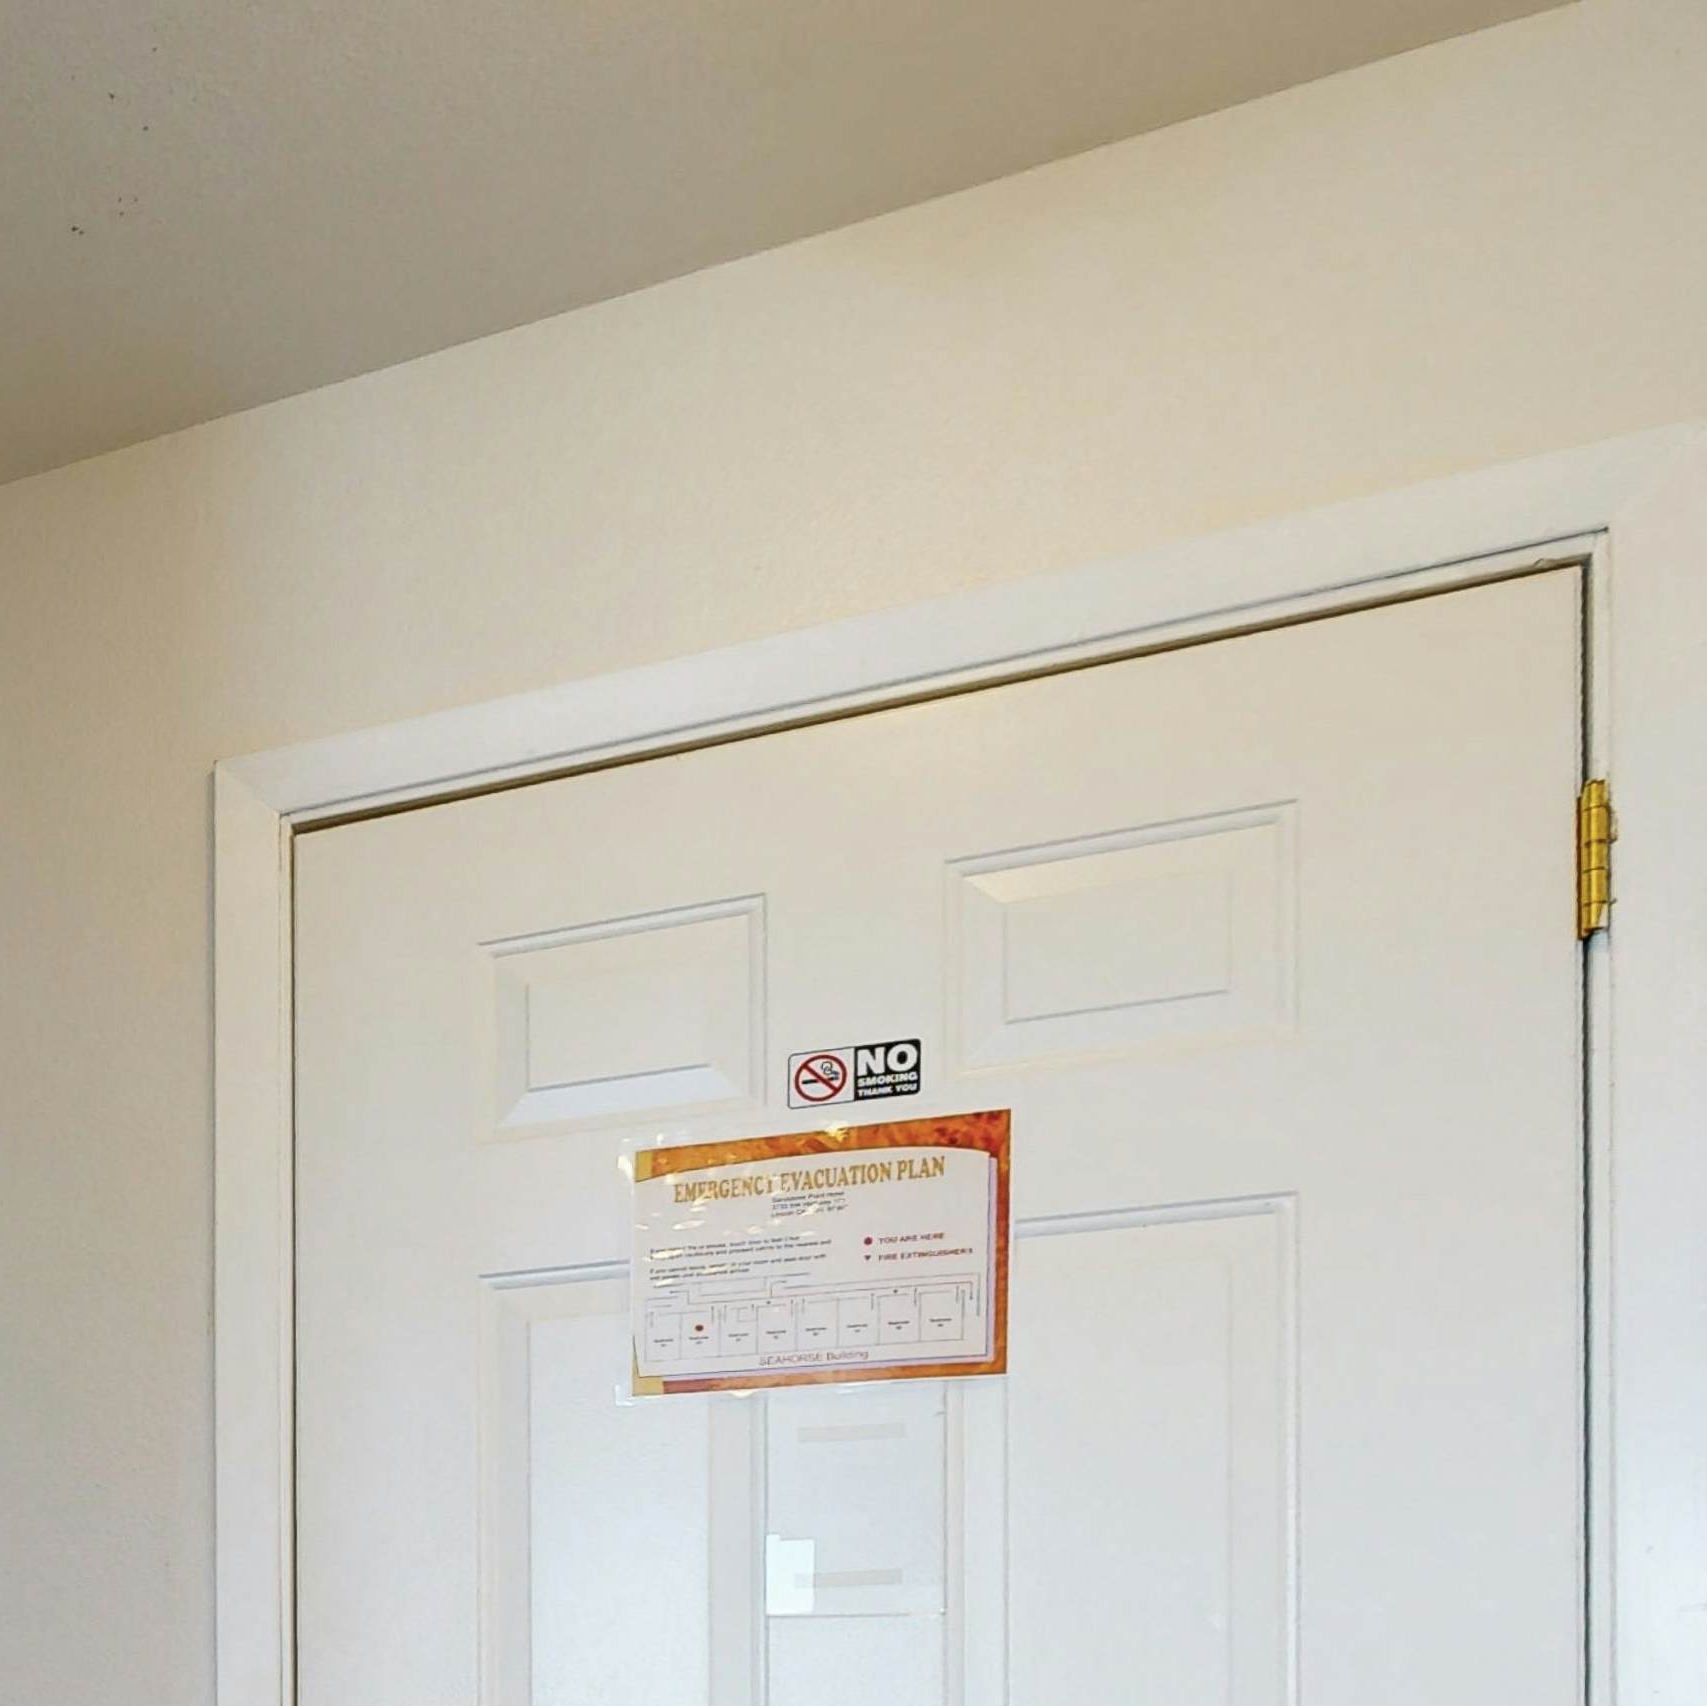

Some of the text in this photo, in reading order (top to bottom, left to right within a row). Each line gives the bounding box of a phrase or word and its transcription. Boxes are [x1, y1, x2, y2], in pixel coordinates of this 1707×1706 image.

[857, 1043, 918, 1077] NO
[857, 1072, 918, 1088] SMOKING
[857, 1083, 918, 1097] THANK YOU
[780, 1161, 893, 1193] EVACUATION
[896, 1155, 946, 1181] PLAN
